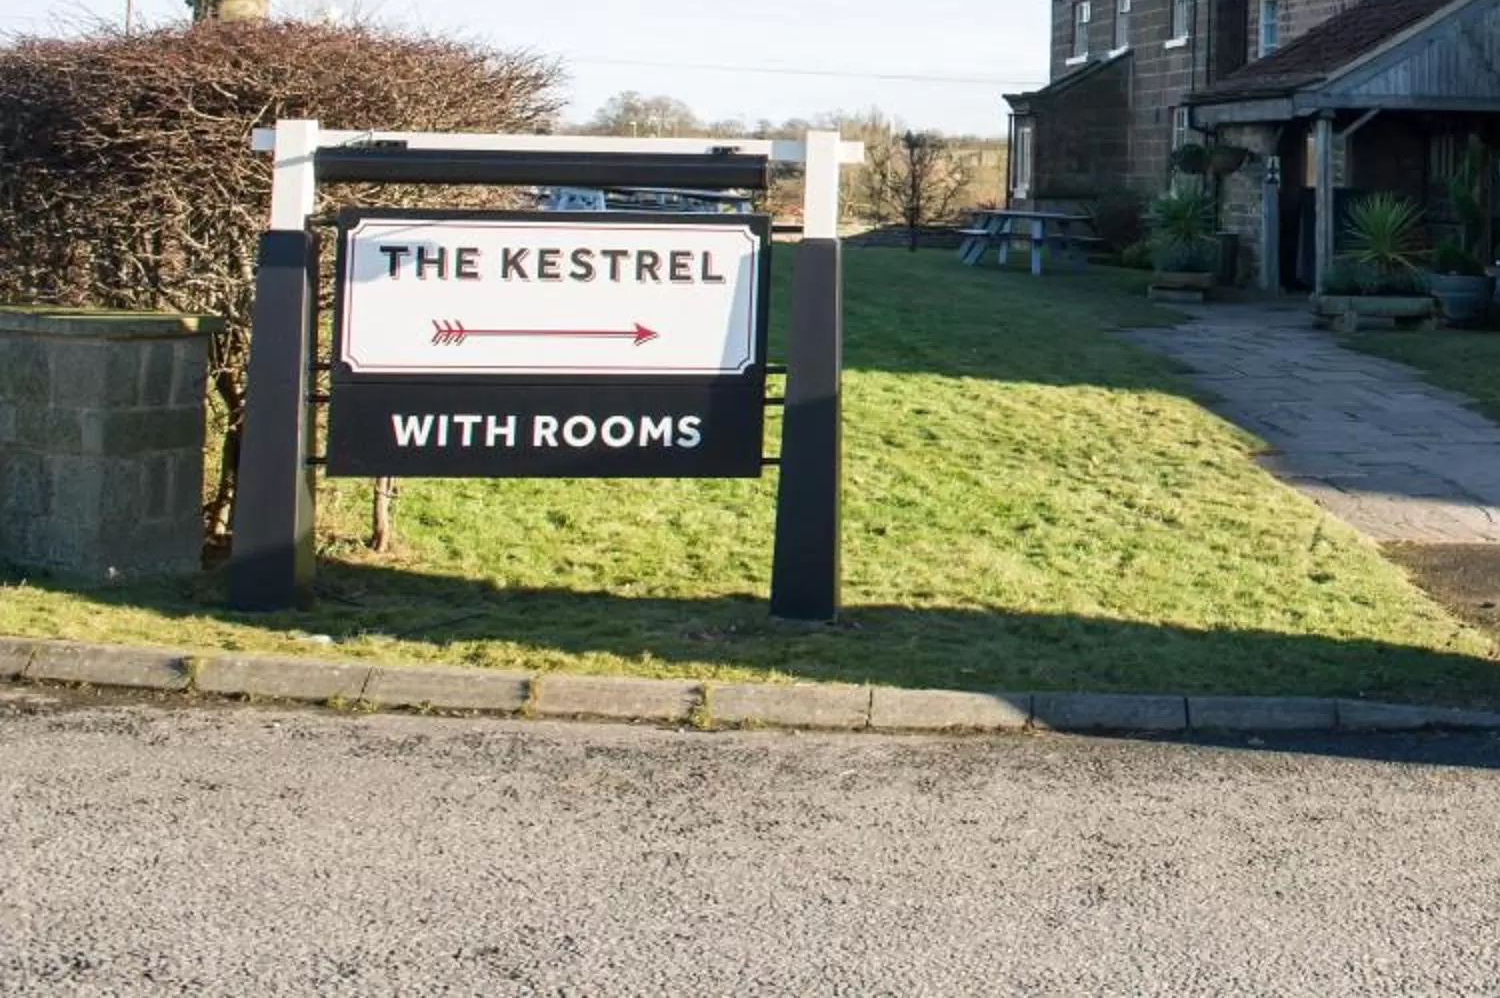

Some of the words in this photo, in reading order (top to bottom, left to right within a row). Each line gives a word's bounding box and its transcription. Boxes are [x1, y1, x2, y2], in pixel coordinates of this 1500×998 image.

[379, 245, 482, 281] THE
[500, 246, 728, 284] KESTREL
[391, 413, 517, 447] WITH
[532, 413, 703, 448] ROOMS
